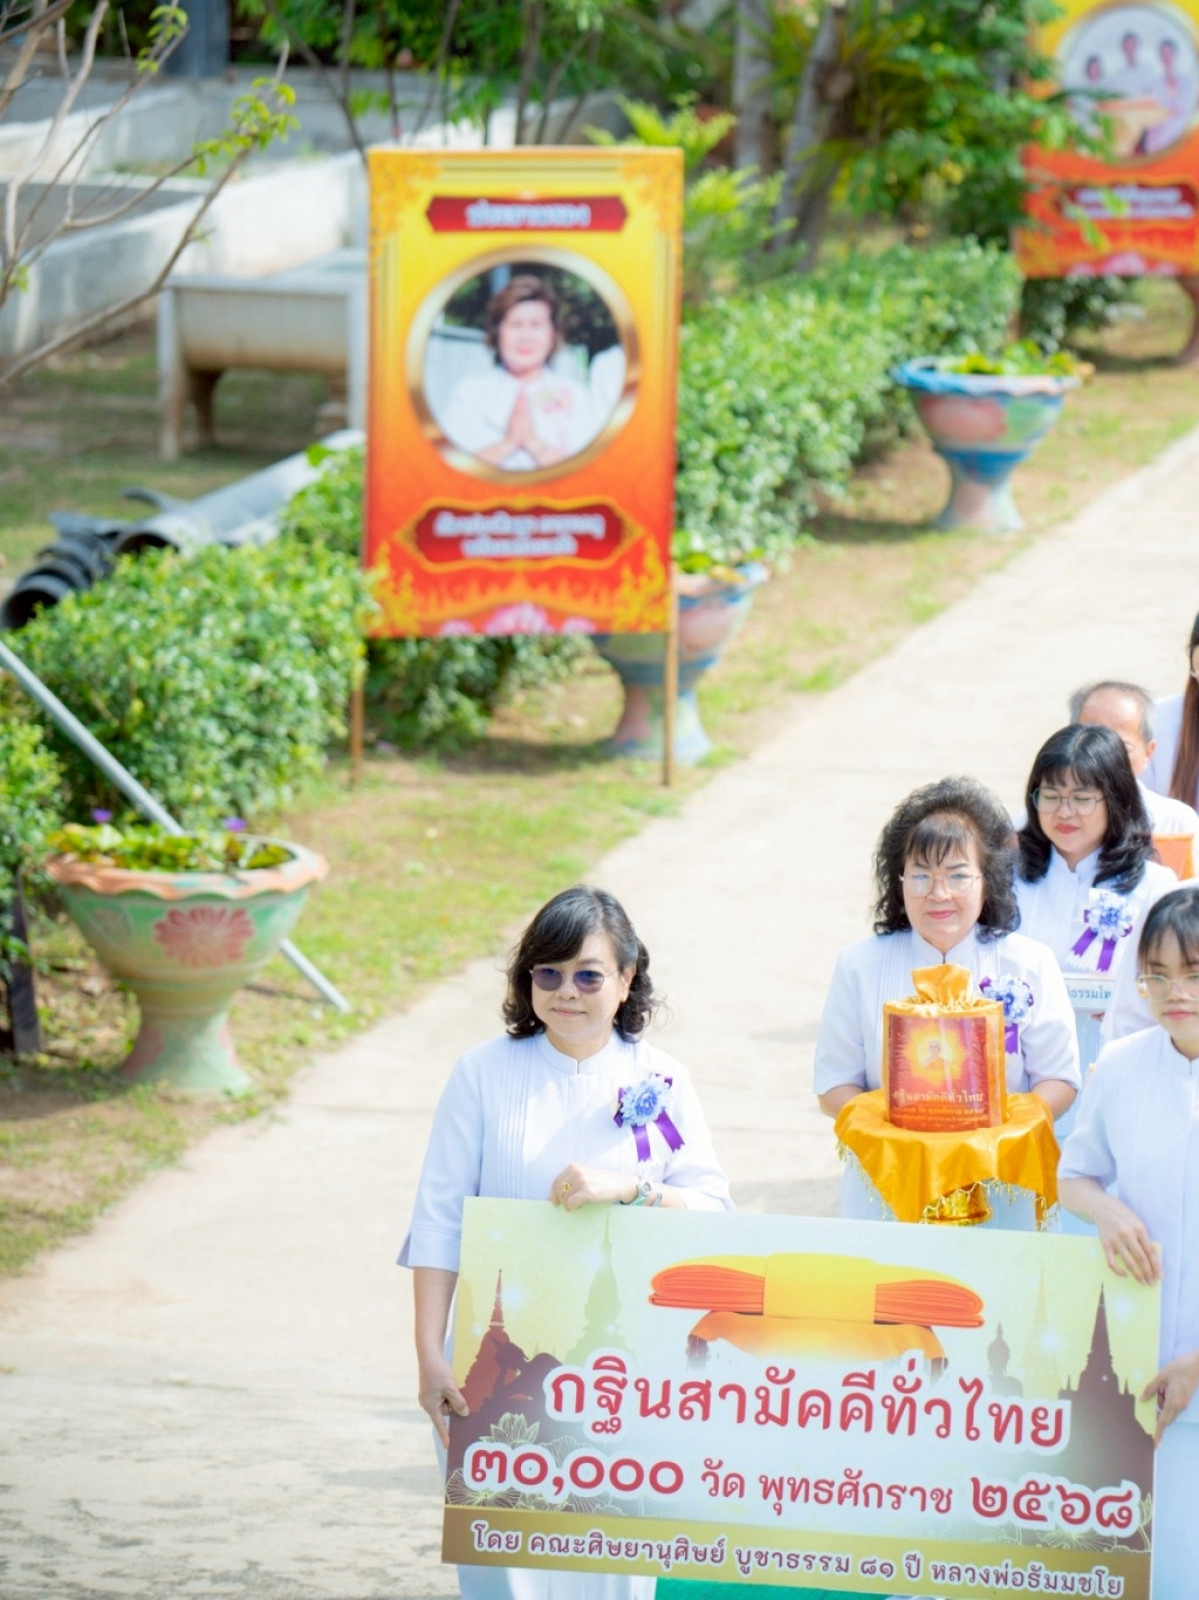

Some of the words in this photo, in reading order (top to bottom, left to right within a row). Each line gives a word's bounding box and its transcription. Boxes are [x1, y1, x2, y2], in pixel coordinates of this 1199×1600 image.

[550, 1355, 1064, 1447] กฐินสามัคคีทั่วไทย
[470, 1449, 685, 1497] ๓๐,๐๐๐
[700, 1457, 746, 1499] วัด
[758, 1467, 953, 1517] พุทธศักราช
[970, 1476, 1133, 1530] ๒๕๖๘
[473, 1523, 520, 1550] โดย
[530, 1531, 726, 1569] คณะศิษยานุศิษย์
[735, 1547, 850, 1575] บูชาธรรม
[860, 1559, 895, 1579] ๘๑
[904, 1553, 921, 1579] ปี
[931, 1558, 1123, 1597] หลวงพ่อธัมมชโย
